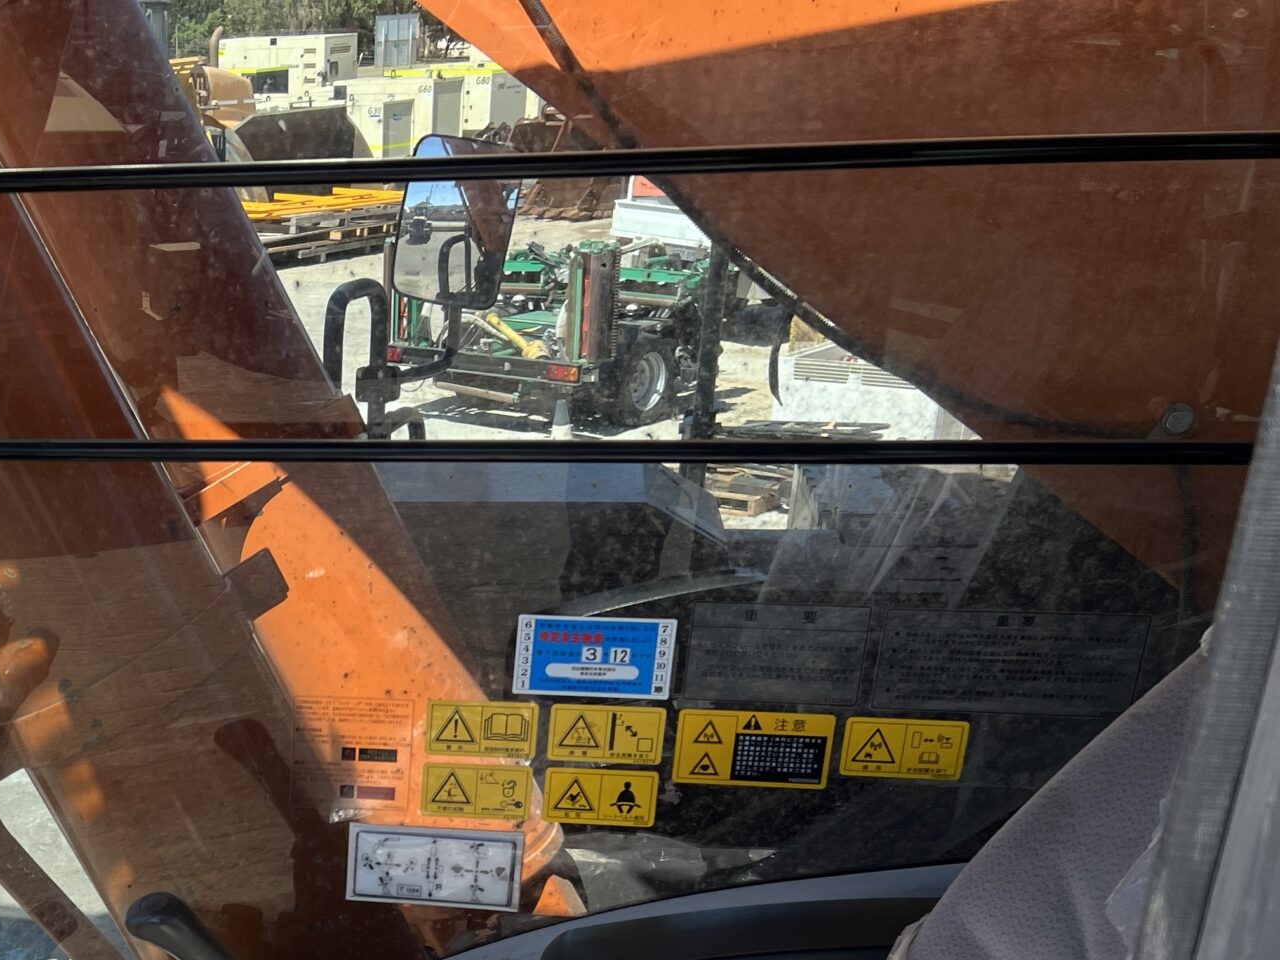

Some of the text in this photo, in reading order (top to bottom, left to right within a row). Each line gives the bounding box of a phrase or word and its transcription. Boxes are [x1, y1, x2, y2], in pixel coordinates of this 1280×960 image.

[476, 76, 491, 85] G80
[418, 85, 432, 94] G60
[368, 106, 382, 115] G30
[525, 621, 532, 629] 6
[661, 625, 669, 633] 7
[524, 633, 531, 641] 5
[659, 637, 668, 646] 8
[523, 644, 529, 653] 4
[585, 647, 598, 661] 3
[612, 649, 628, 663] 12
[658, 650, 666, 658] 9
[521, 656, 529, 664] 3
[656, 662, 666, 670] 10
[520, 668, 528, 676] 2
[654, 674, 664, 682] 11
[774, 718, 808, 732] 注意
